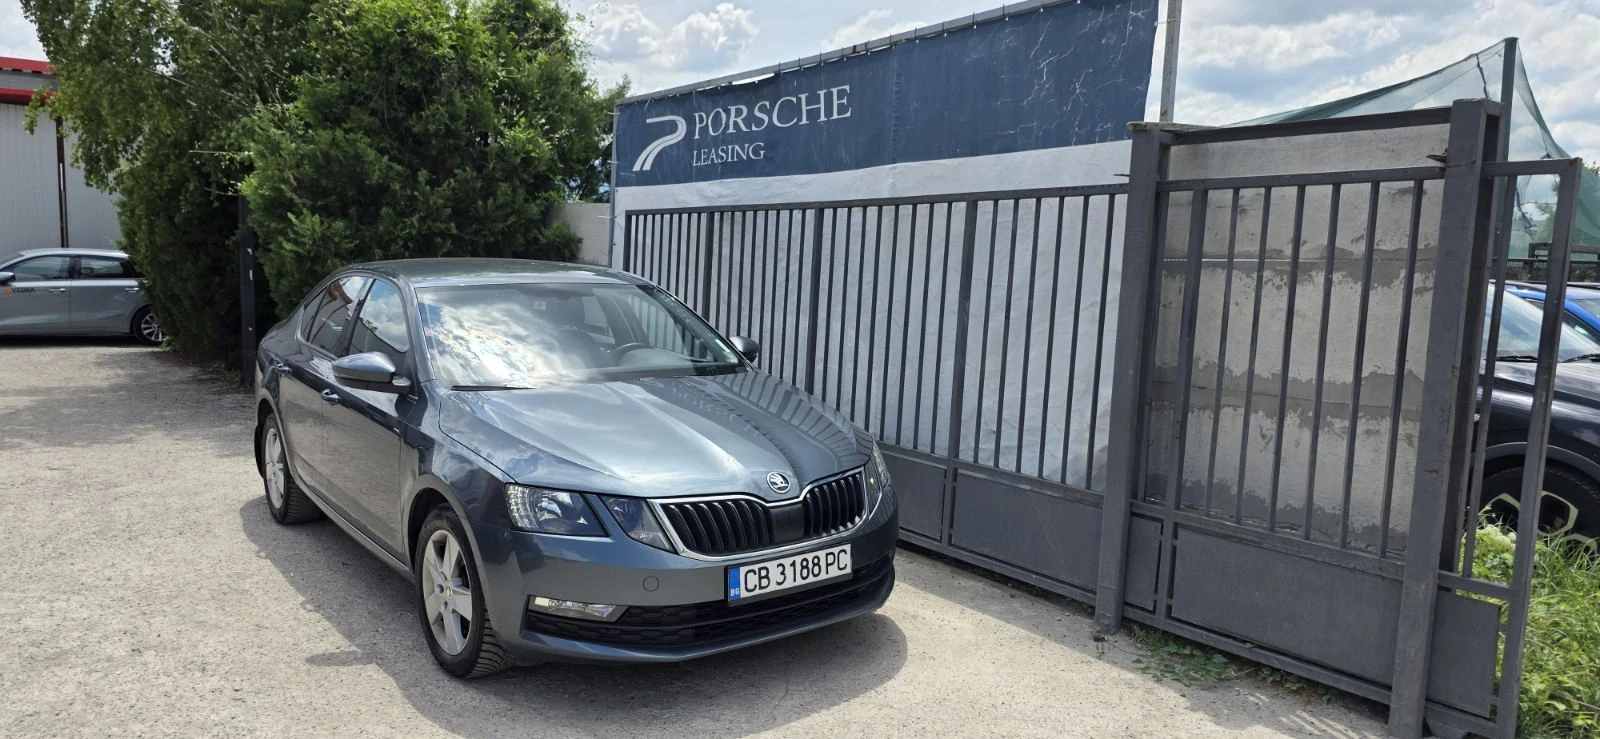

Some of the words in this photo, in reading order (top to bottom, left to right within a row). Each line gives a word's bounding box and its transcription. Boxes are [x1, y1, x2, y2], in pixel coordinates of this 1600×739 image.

[693, 84, 851, 139] PORSCHE
[692, 142, 765, 167] LEASING
[744, 566, 770, 593] CB
[776, 555, 822, 585] 3188
[826, 549, 848, 575] PC
[730, 587, 740, 596] BG
